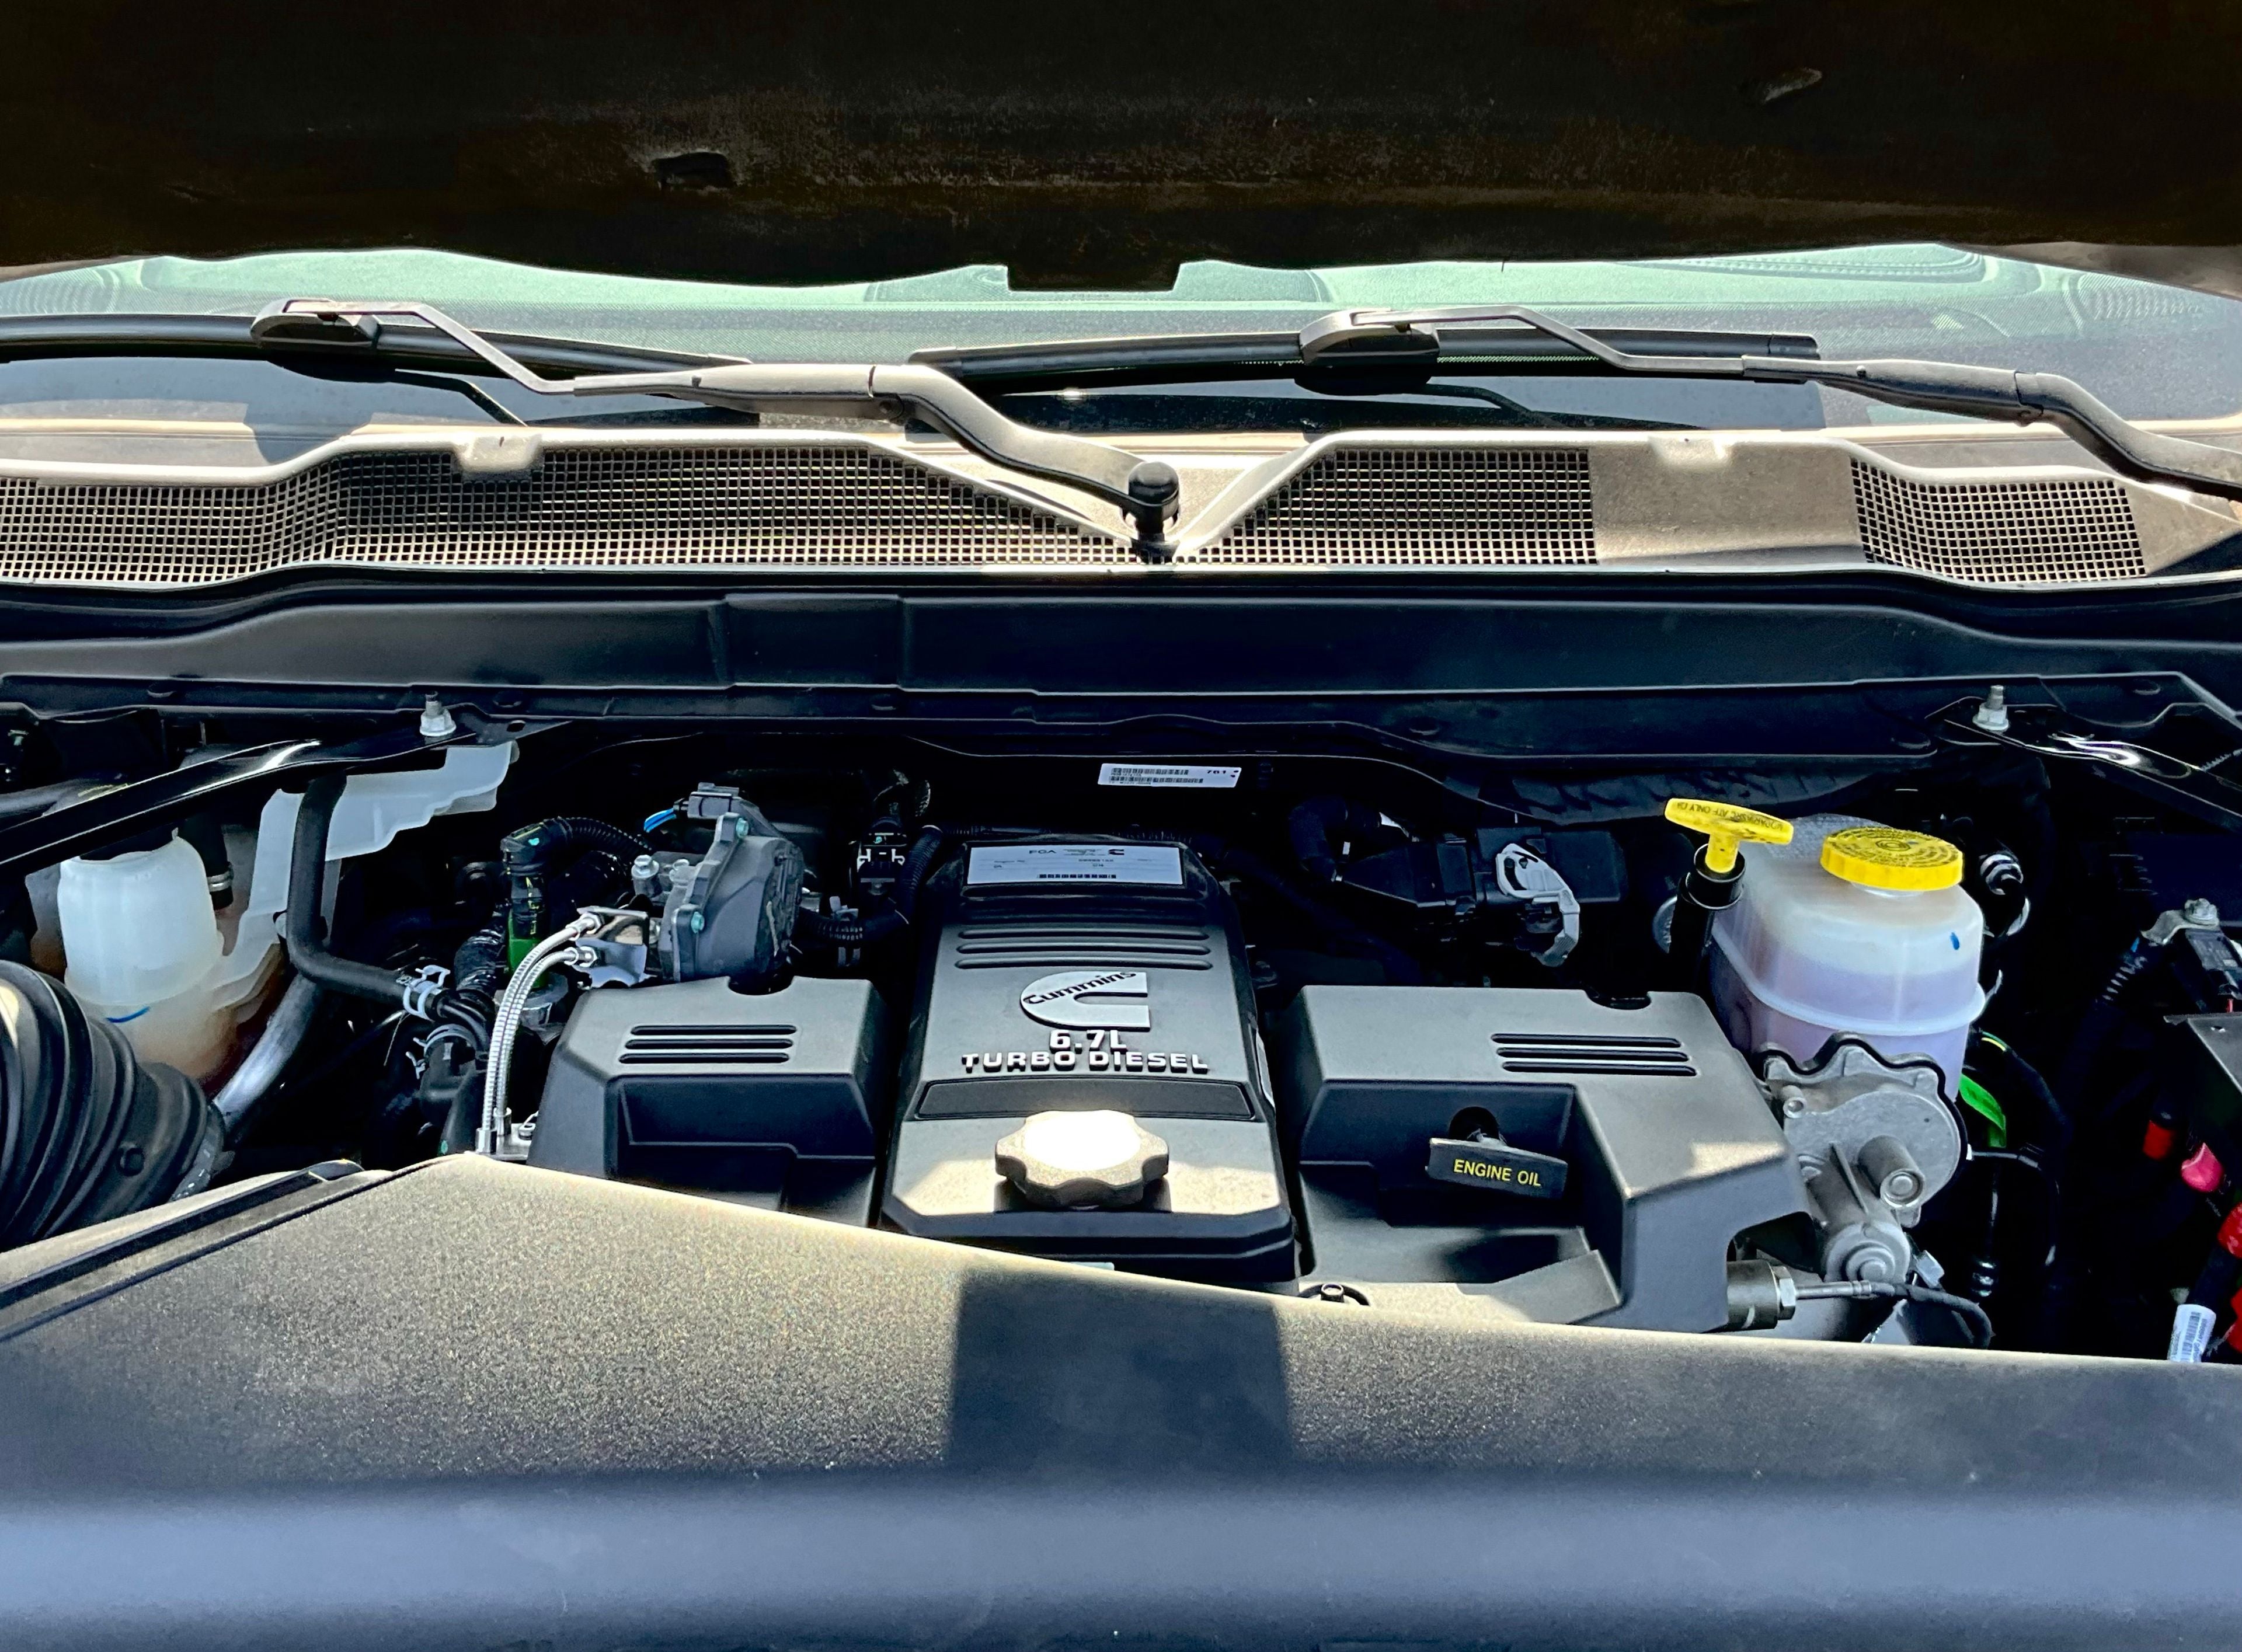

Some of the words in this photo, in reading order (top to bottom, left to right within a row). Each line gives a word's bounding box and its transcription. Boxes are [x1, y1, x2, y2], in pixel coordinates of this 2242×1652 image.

[1689, 804, 1711, 814] ONLY
[1023, 971, 1137, 1005] Cummins
[1049, 1029, 1128, 1054] 6.7L
[961, 1051, 1077, 1074] TURBO
[1088, 1051, 1209, 1074] DIESEL
[1453, 1158, 1512, 1182] ENGINE
[1517, 1170, 1542, 1187] OIL
